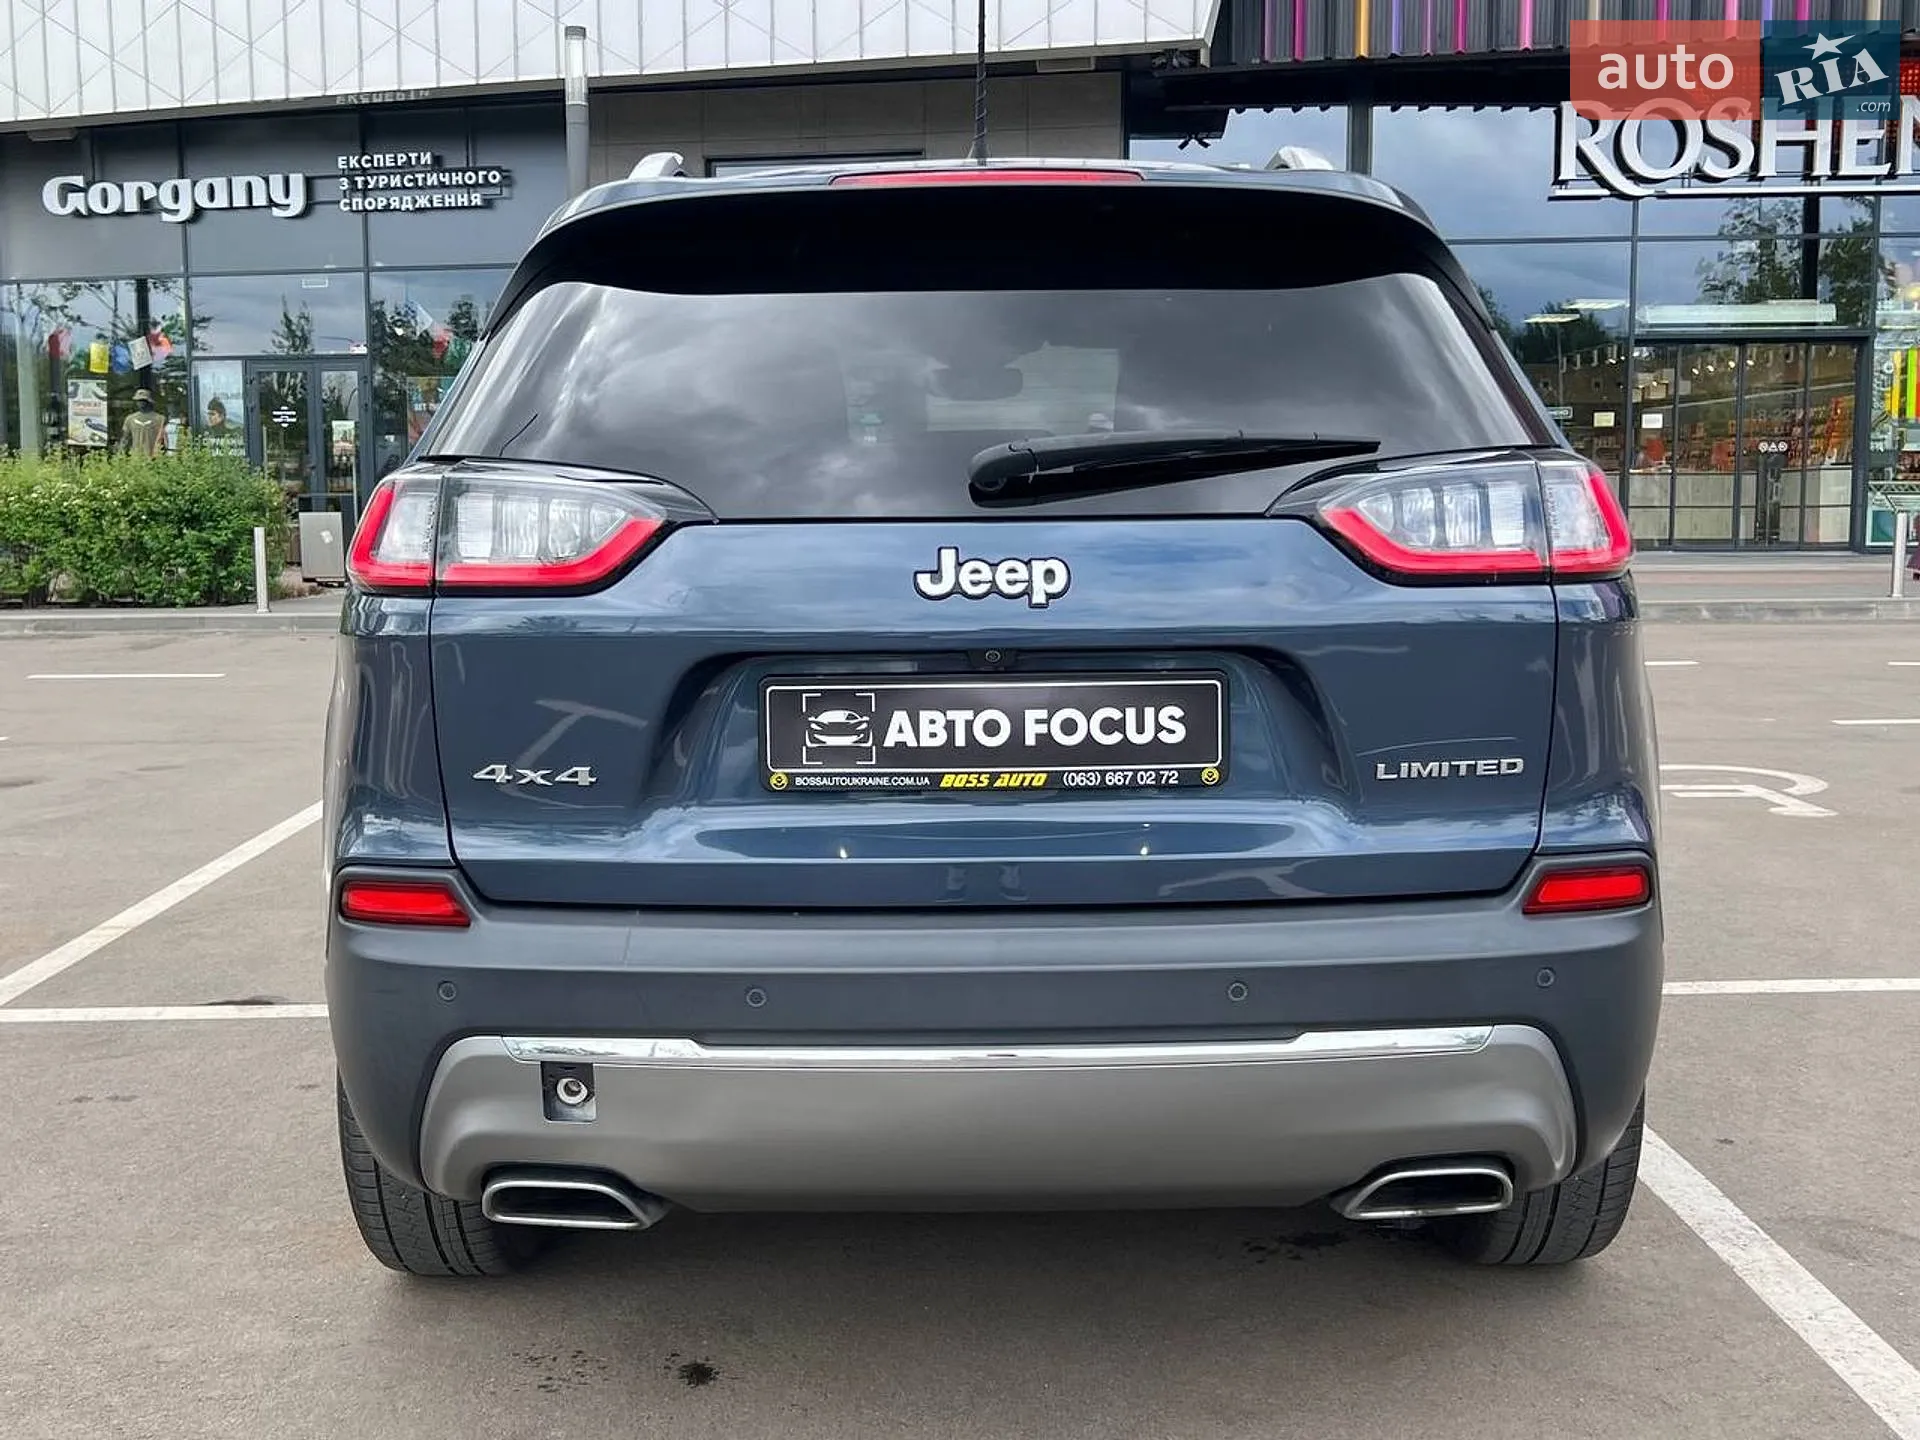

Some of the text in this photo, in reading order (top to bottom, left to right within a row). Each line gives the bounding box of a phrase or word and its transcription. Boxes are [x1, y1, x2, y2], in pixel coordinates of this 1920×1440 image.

[337, 151, 433, 169] ЕКСПЕРТИ
[354, 170, 501, 190] ТУРИСТИЧНОГО
[42, 173, 306, 223] Gorgany
[339, 193, 483, 212] СПОРЯДЖЕННЯ
[915, 547, 1070, 607] Jeep
[1024, 705, 1187, 746] FOCUS
[794, 775, 931, 787] BOSSAUTOUKRAINE.COM.UA
[939, 773, 990, 788] BOSS
[1063, 771, 1101, 787] (063)
[1105, 771, 1133, 786] 667
[1137, 771, 1157, 786] 02
[1159, 770, 1179, 785] 72
[1376, 757, 1525, 780] LIMITED
